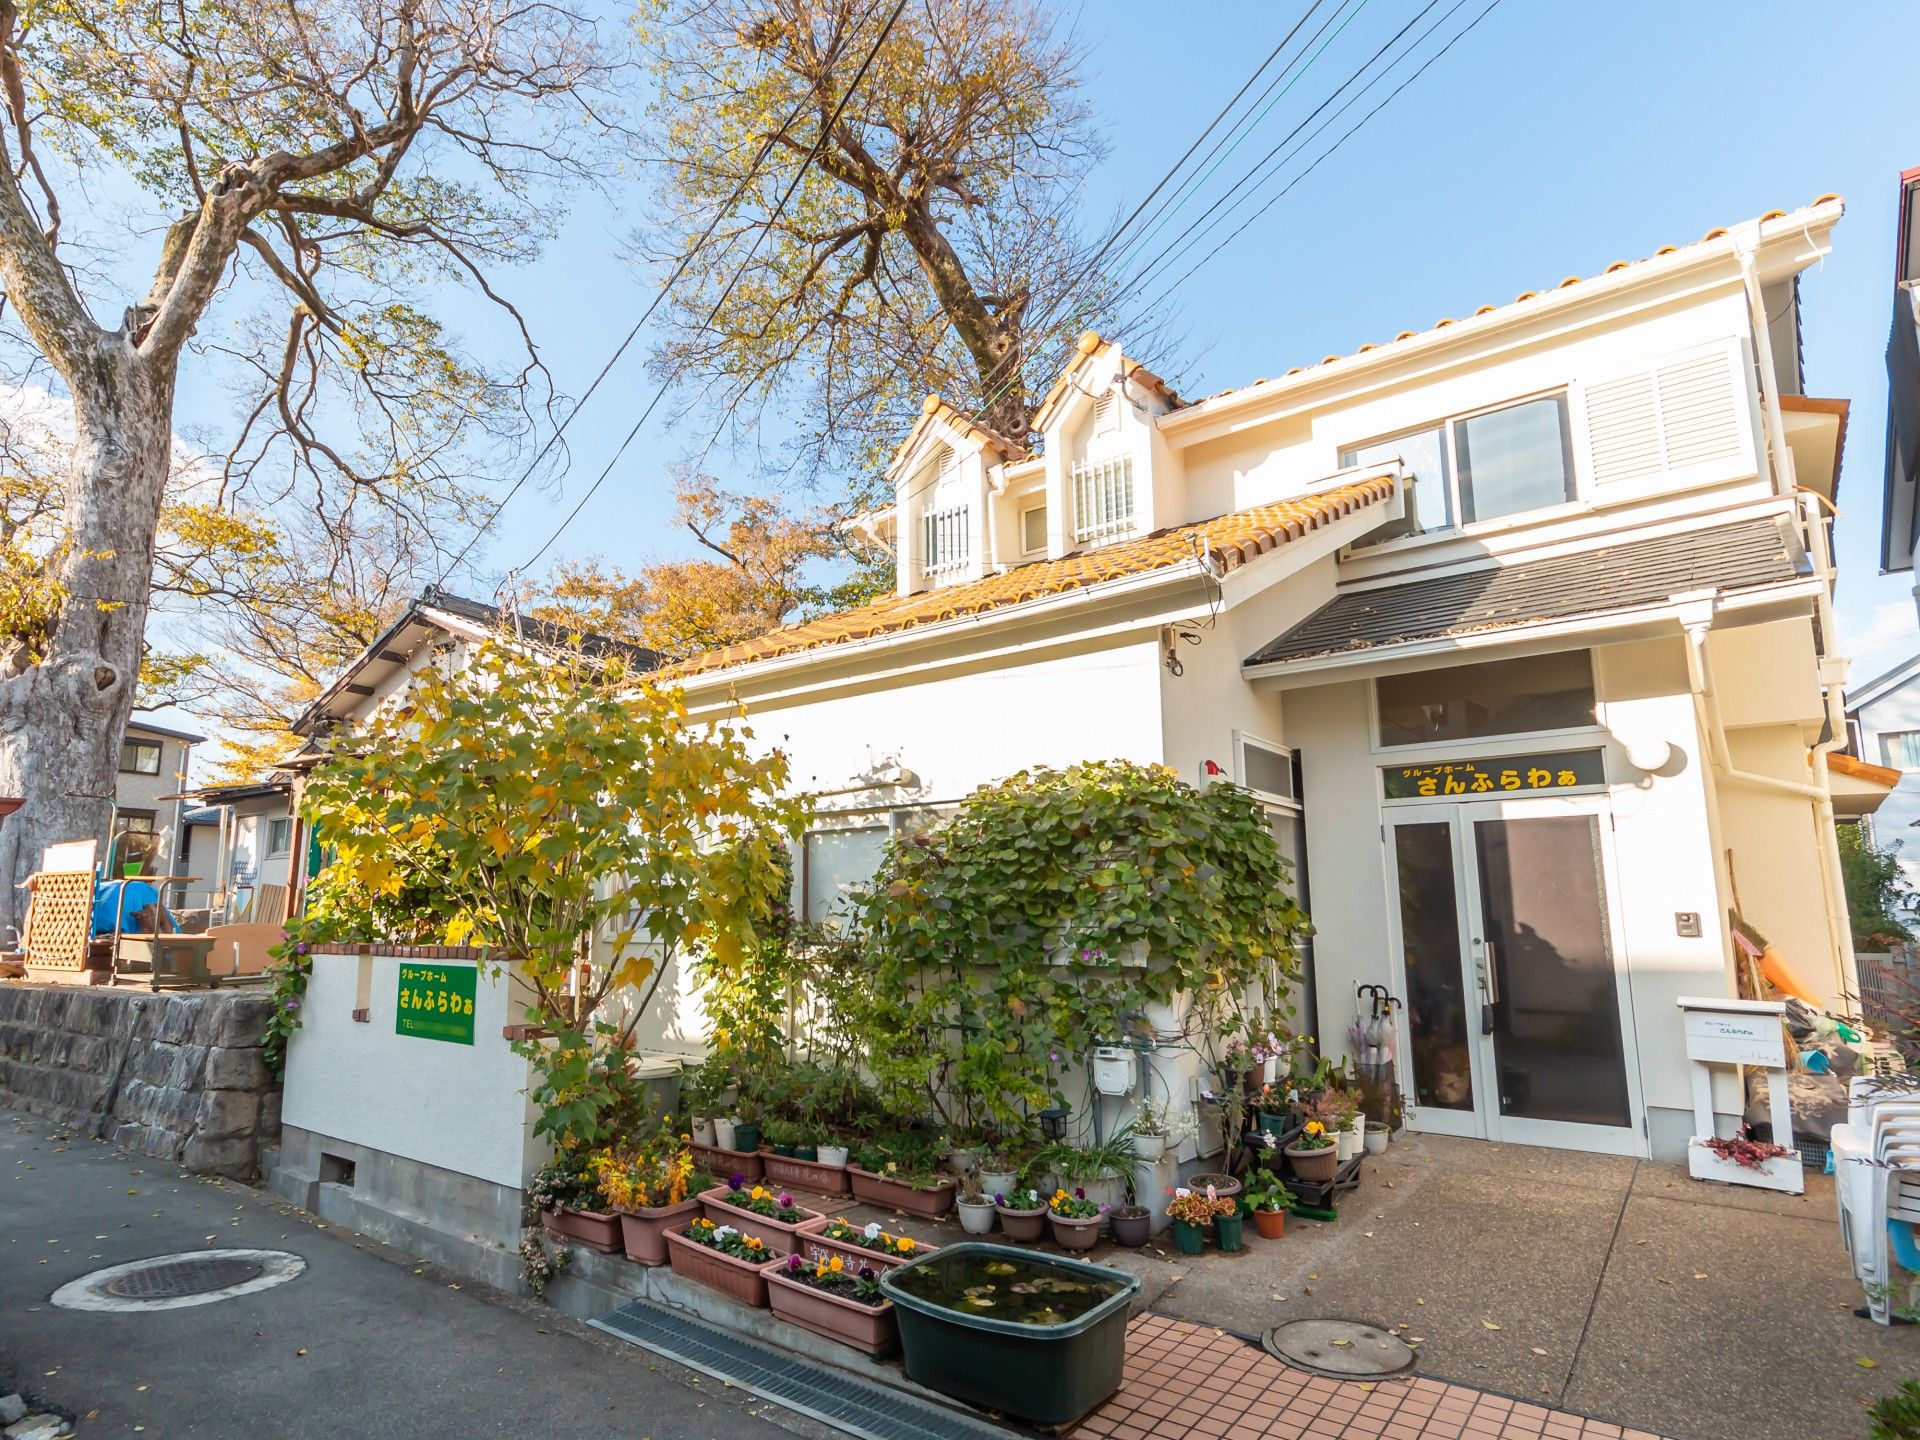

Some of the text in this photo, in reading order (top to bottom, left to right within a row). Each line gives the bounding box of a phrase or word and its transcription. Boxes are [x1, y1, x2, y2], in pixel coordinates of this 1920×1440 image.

[1403, 764, 1475, 777] グループホーム
[1417, 767, 1577, 797] さんふらわぁ
[402, 969, 446, 982] グループホーム
[400, 987, 473, 1016] さんふらわぁ
[403, 1019, 414, 1028] TEL
